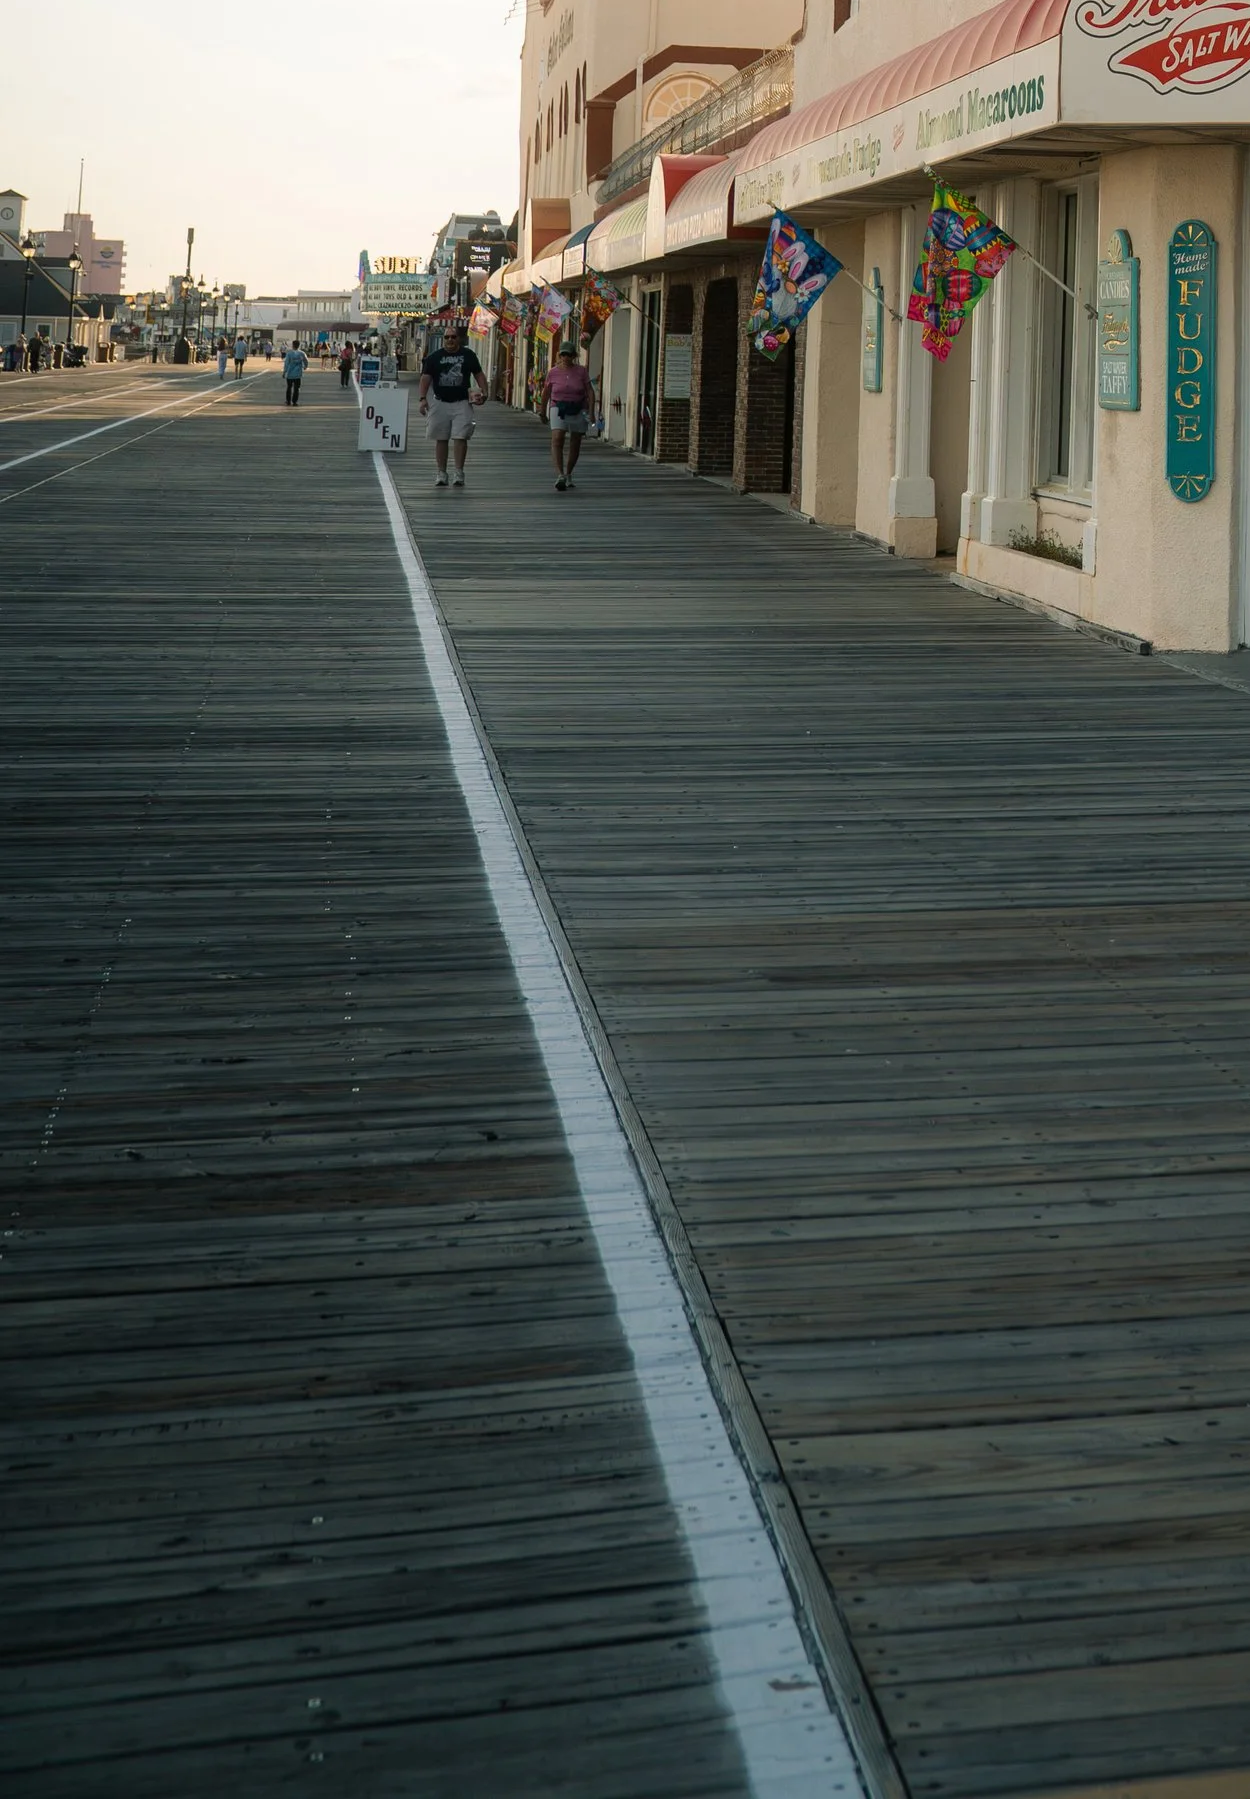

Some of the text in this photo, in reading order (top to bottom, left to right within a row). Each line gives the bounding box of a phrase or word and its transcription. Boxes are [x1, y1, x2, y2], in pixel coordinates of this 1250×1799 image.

[1162, 31, 1217, 72] SALT
[967, 74, 1045, 134] Macaroons
[373, 255, 422, 274] SURF
[398, 284, 423, 292] RECORDS
[1099, 279, 1130, 301] CANDIES
[1175, 279, 1204, 442] FUDGE
[1102, 375, 1128, 395] TAFFY
[366, 405, 400, 448] OPEN
